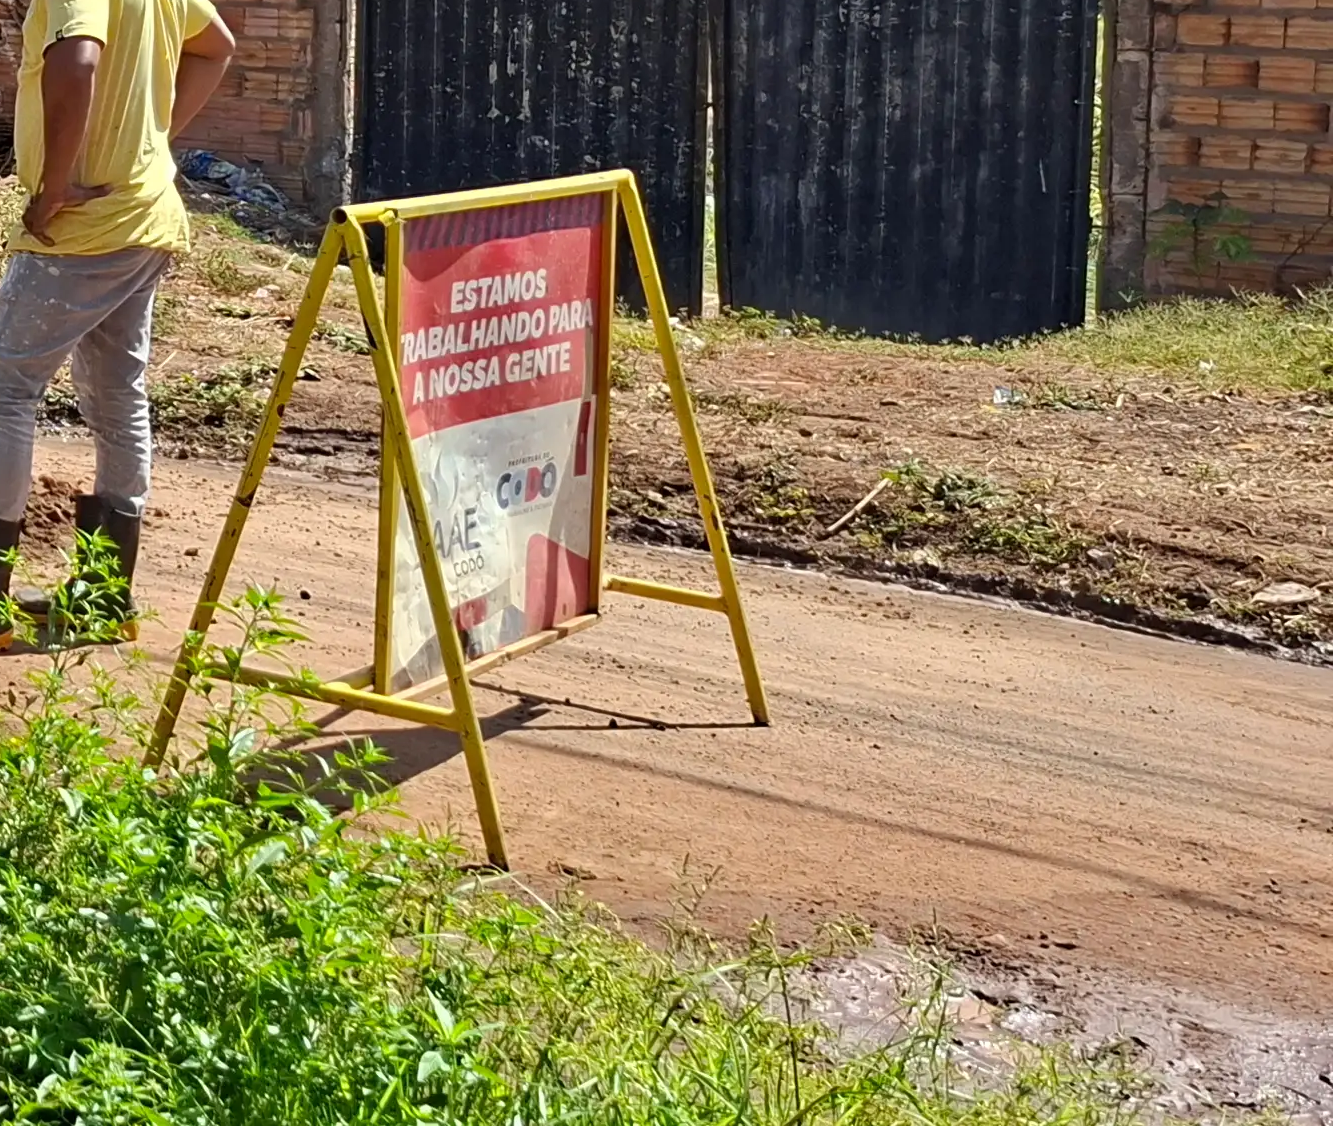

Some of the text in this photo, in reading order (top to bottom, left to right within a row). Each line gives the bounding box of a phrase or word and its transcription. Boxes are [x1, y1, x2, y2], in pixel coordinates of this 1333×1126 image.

[450, 267, 547, 313] ESTAMOS
[548, 298, 594, 335] PARA
[413, 341, 571, 405] A NOSSA GENTE
[453, 551, 485, 577] CODÓ
